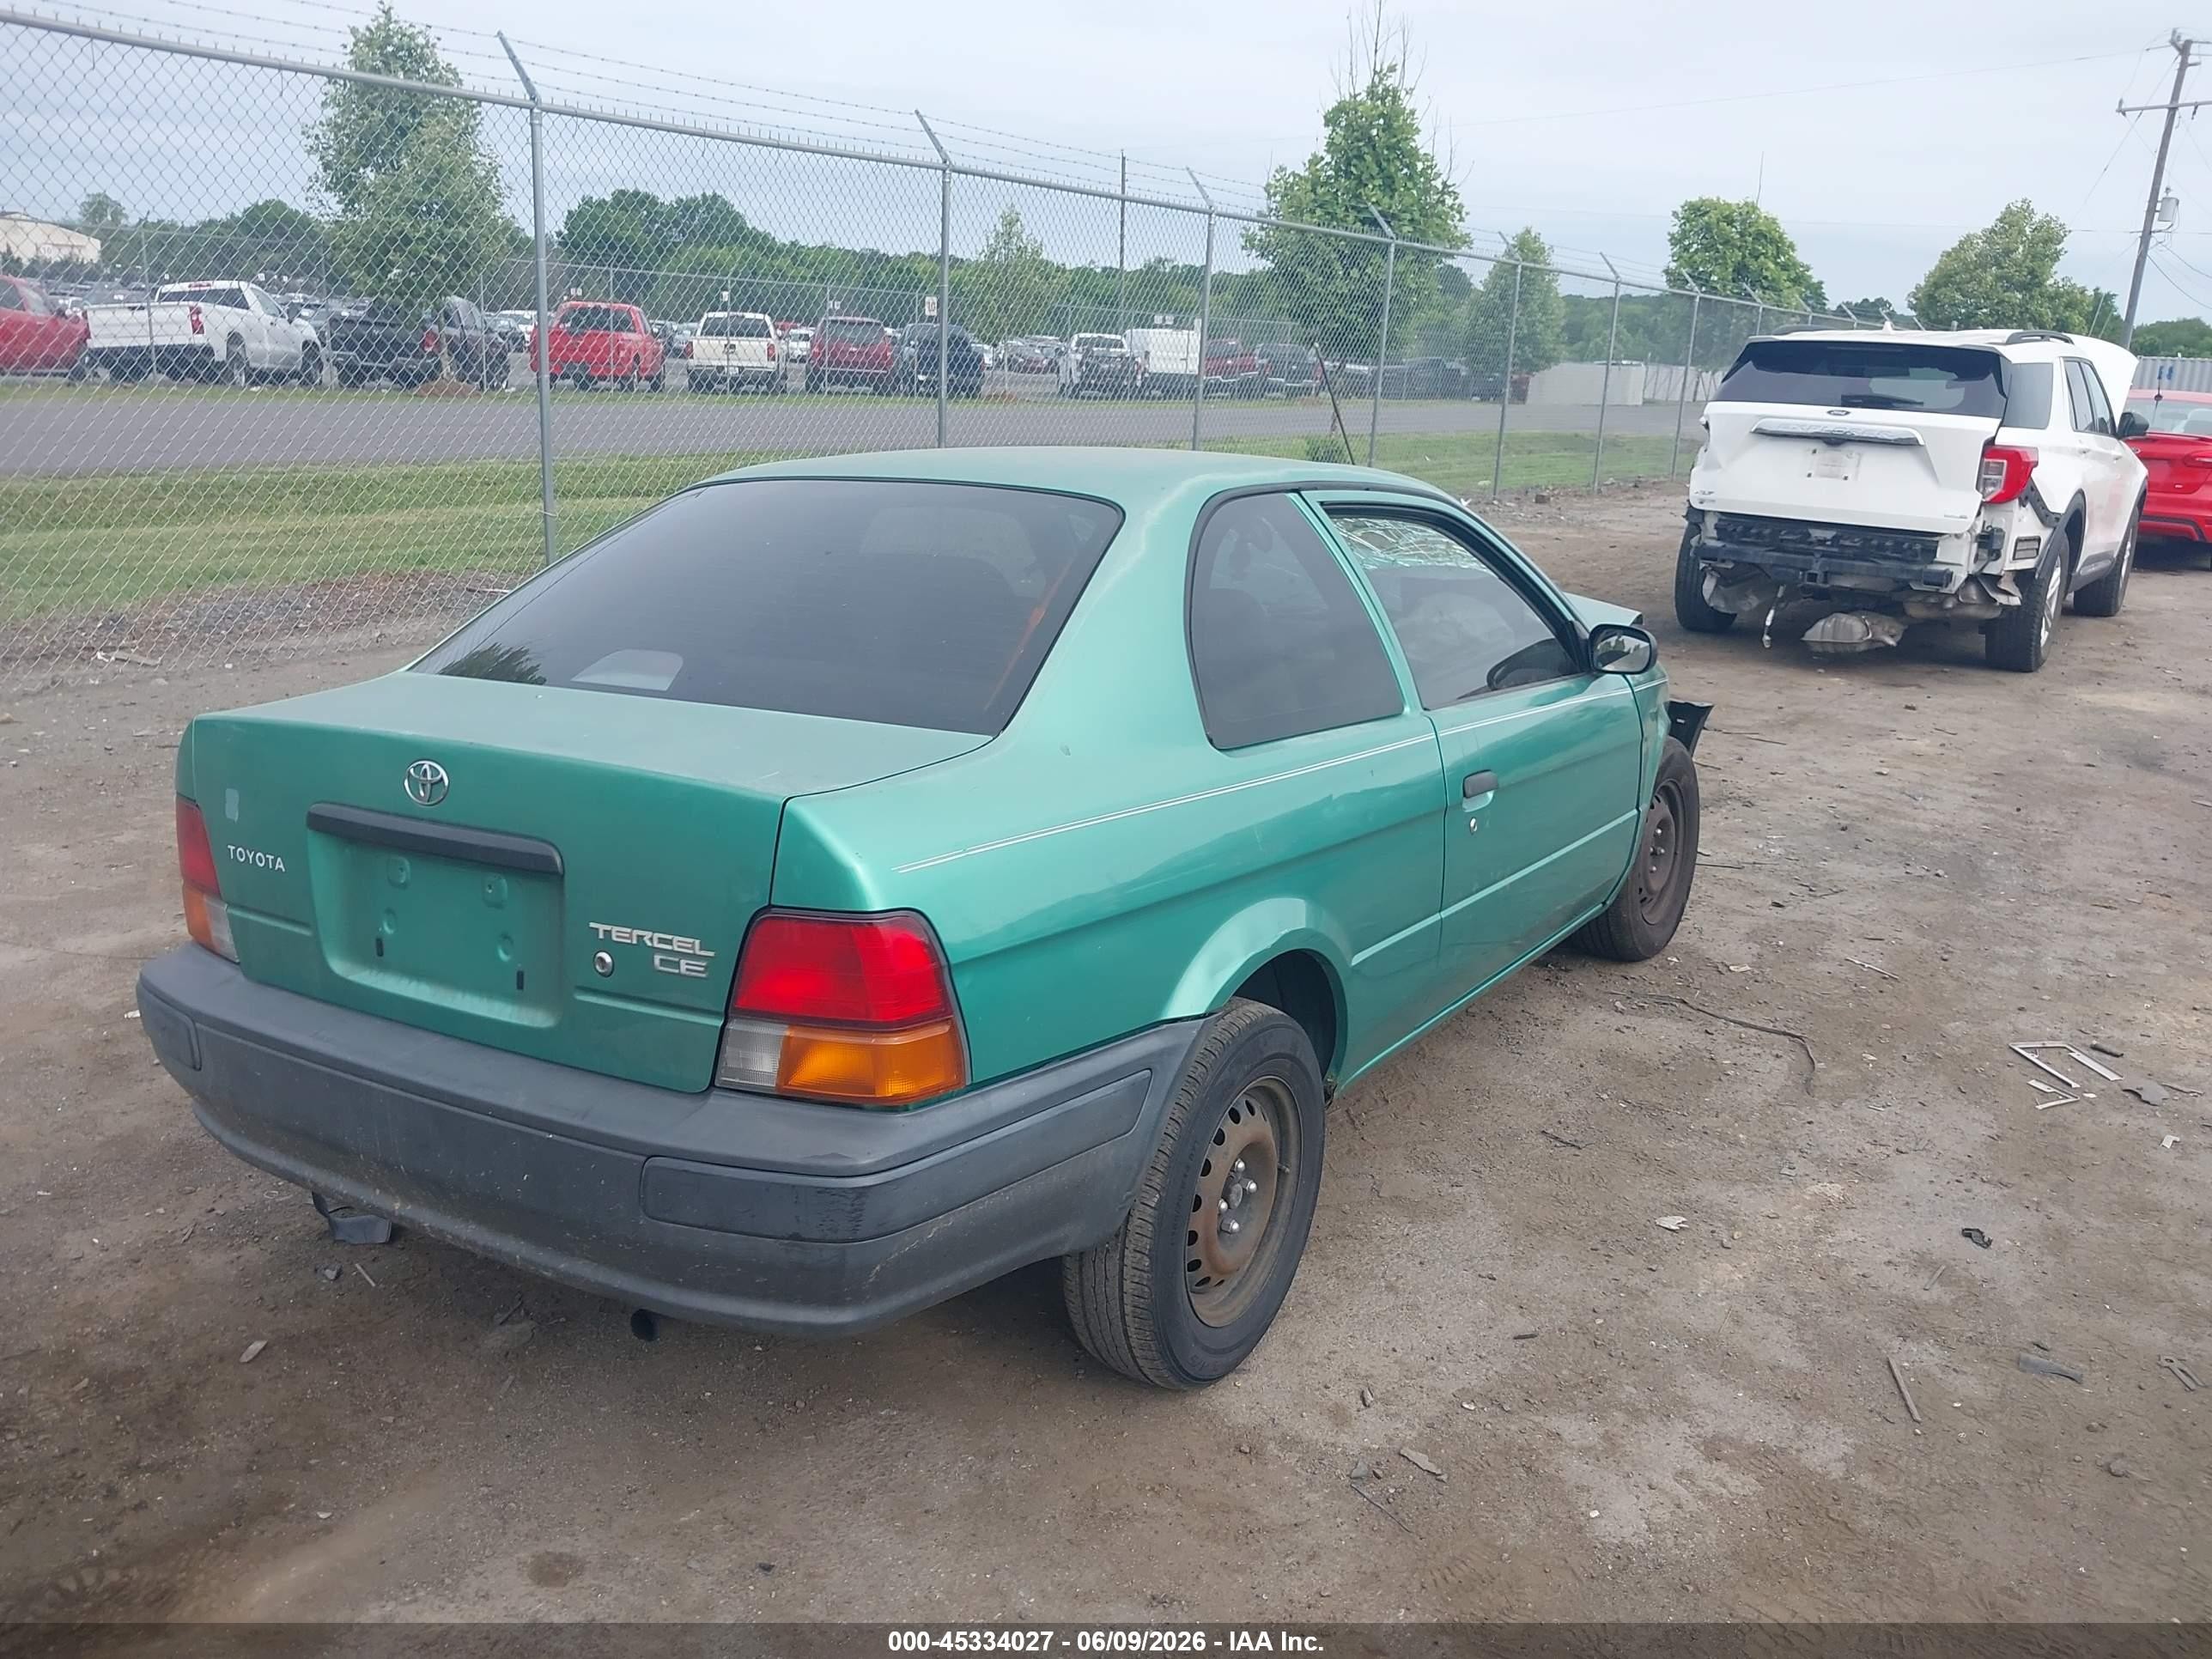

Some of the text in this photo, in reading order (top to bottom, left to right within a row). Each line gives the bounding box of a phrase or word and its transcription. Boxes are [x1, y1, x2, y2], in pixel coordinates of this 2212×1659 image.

[227, 844, 286, 872] TOYOTA
[588, 921, 715, 957] TERCEL
[653, 954, 707, 977] CE
